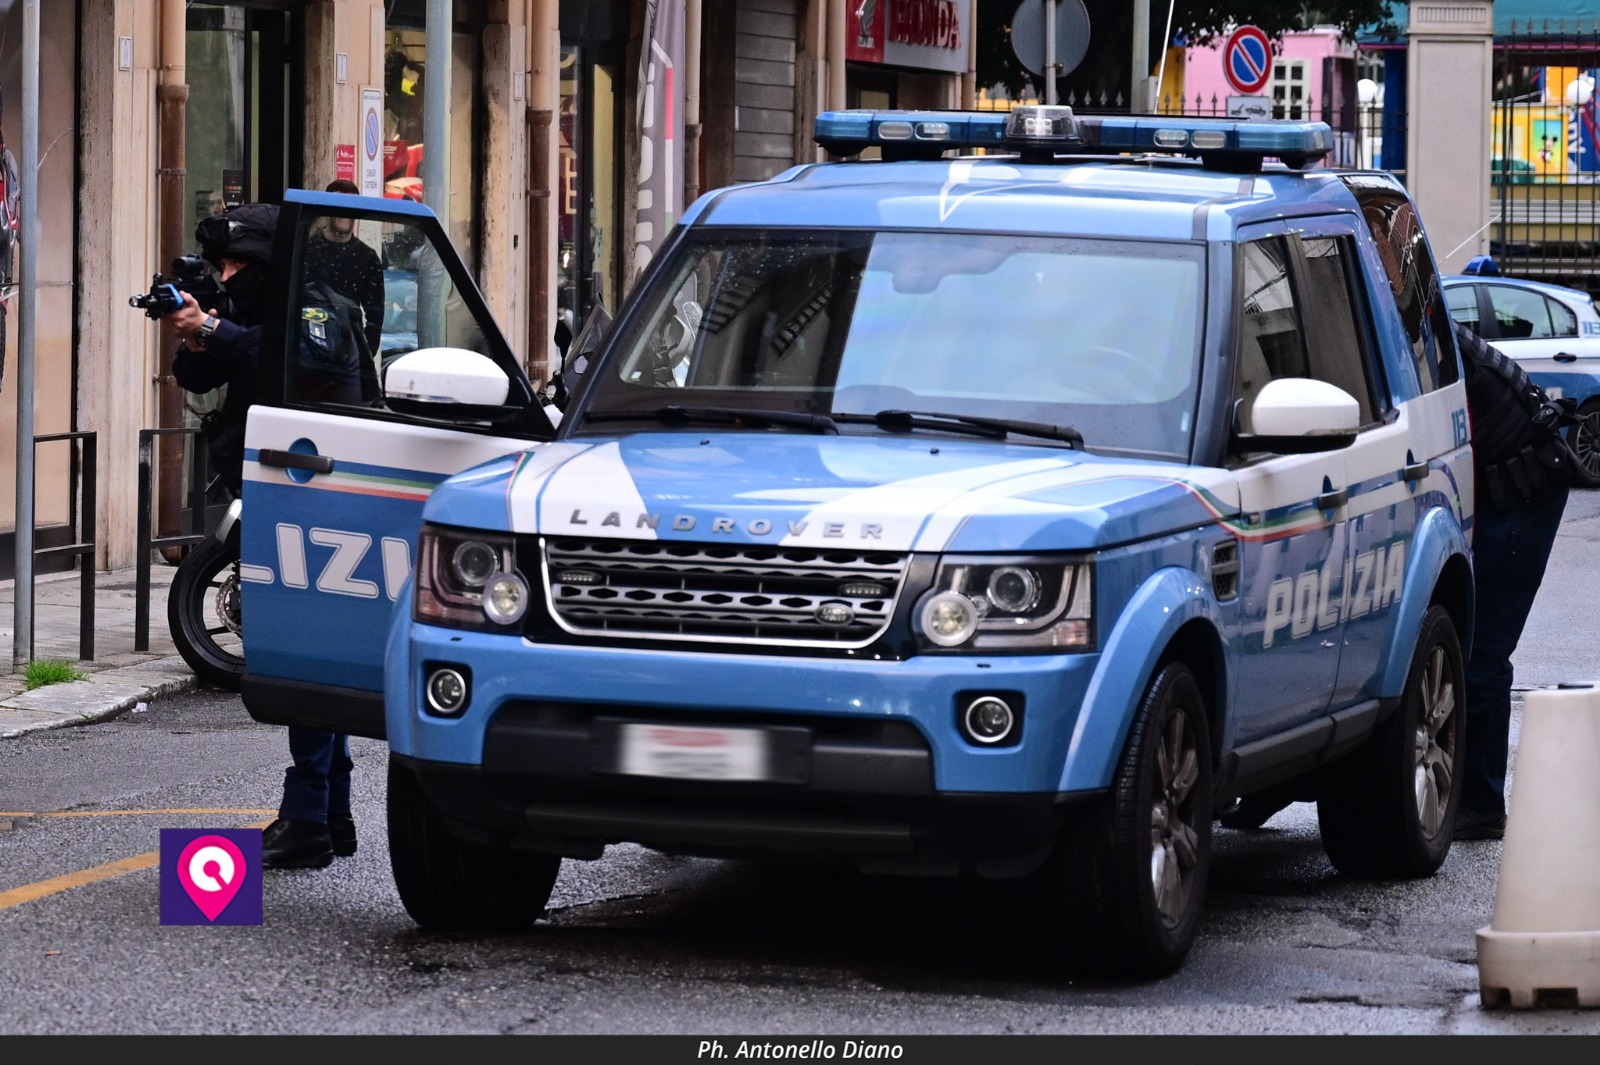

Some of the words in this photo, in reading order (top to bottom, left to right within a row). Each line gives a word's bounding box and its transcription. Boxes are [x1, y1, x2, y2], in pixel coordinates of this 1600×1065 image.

[888, 0, 962, 50] HONDA
[1451, 408, 1467, 449] 113
[1263, 540, 1405, 650] POLIZIA
